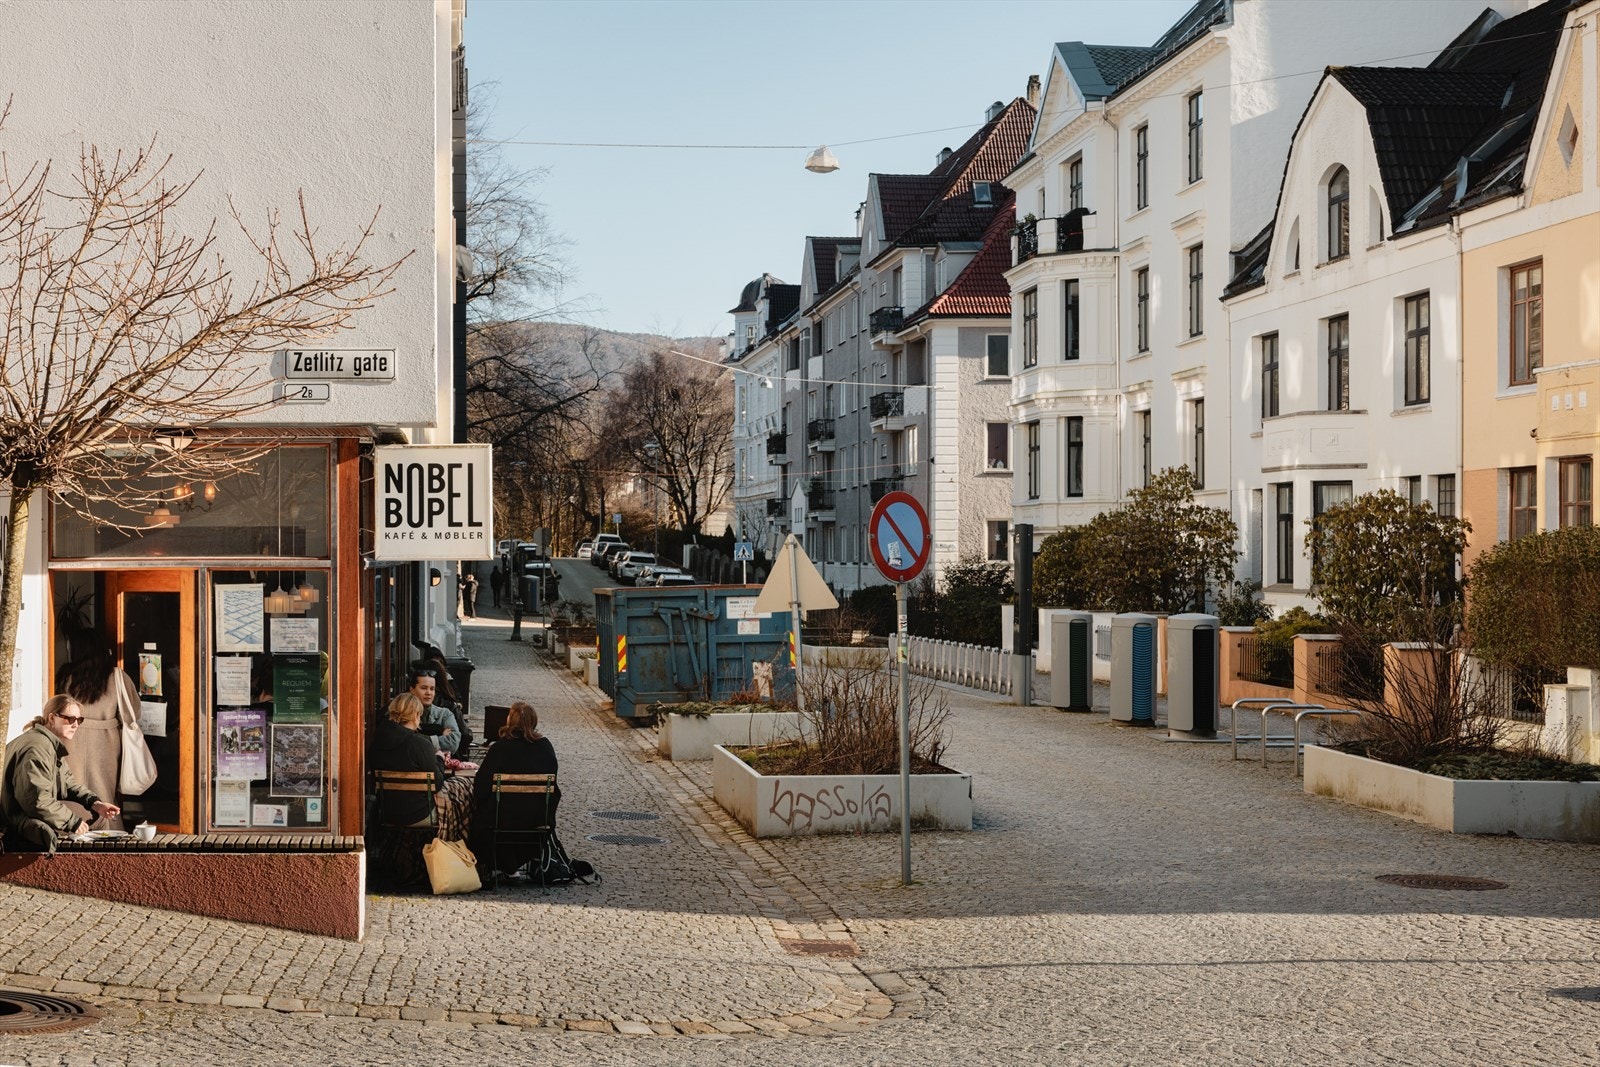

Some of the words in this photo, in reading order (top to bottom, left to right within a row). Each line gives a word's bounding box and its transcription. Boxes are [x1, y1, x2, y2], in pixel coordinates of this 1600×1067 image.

[293, 352, 344, 372] Zetlitz
[353, 353, 387, 376] gate
[301, 386, 313, 398] 2B
[384, 463, 483, 497] NOBEL
[384, 493, 483, 528] BOPEL
[384, 531, 415, 540] KAFÉ
[420, 532, 428, 540] &
[434, 532, 483, 540] MØBLER
